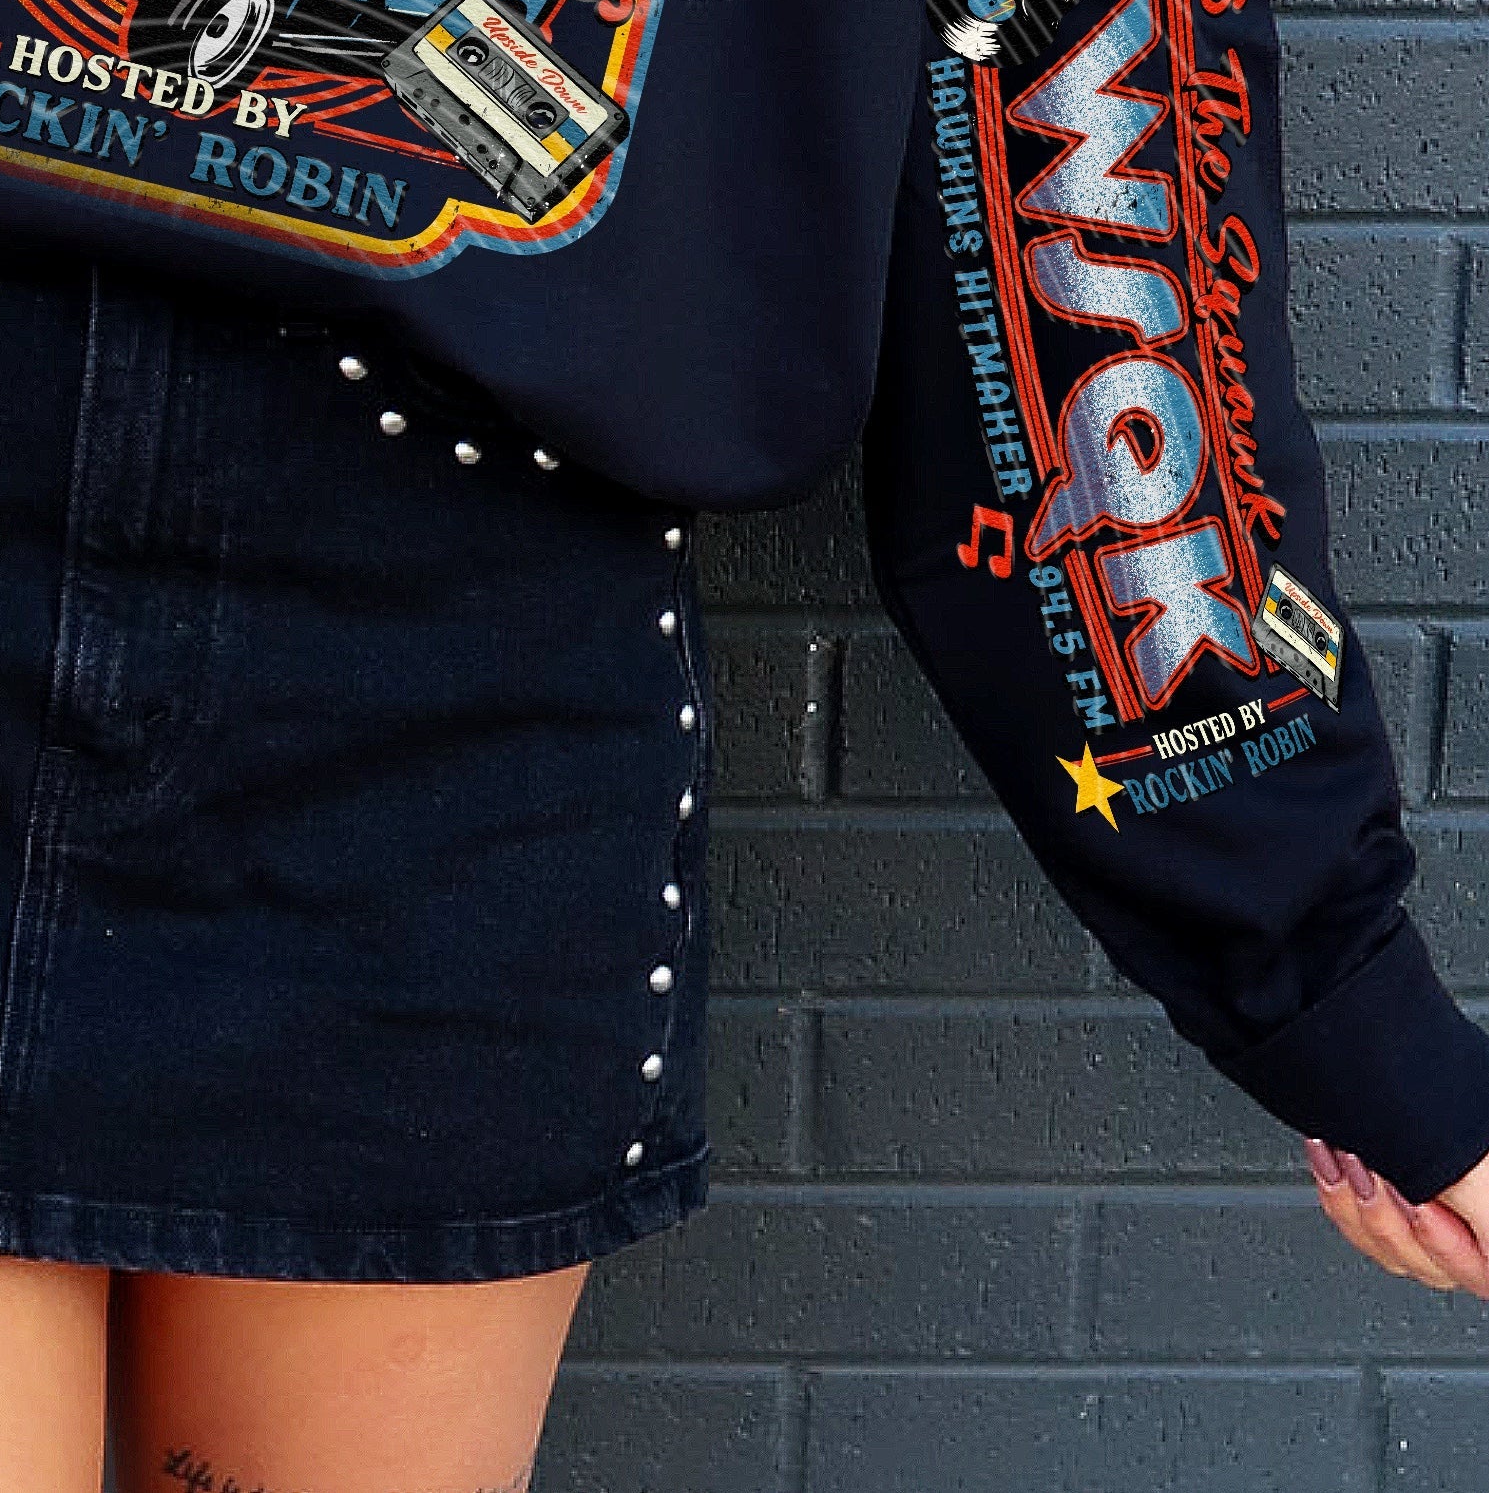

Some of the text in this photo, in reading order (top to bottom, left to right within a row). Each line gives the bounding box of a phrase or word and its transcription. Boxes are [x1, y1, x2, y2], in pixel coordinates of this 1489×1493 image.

[8, 34, 308, 138] HOSTED BY
[482, 16, 587, 115] Upside Down
[190, 131, 409, 229] ROBIN
[929, 56, 1034, 498] HAWKINS HITMAKER
[1186, 47, 1287, 540] The Squawk
[1028, 565, 1116, 729] 94.5 FM
[1284, 581, 1333, 634] Upside Down
[1121, 712, 1318, 815] ROCKIN' ROBIN
[1152, 698, 1267, 760] HOSTED BY
